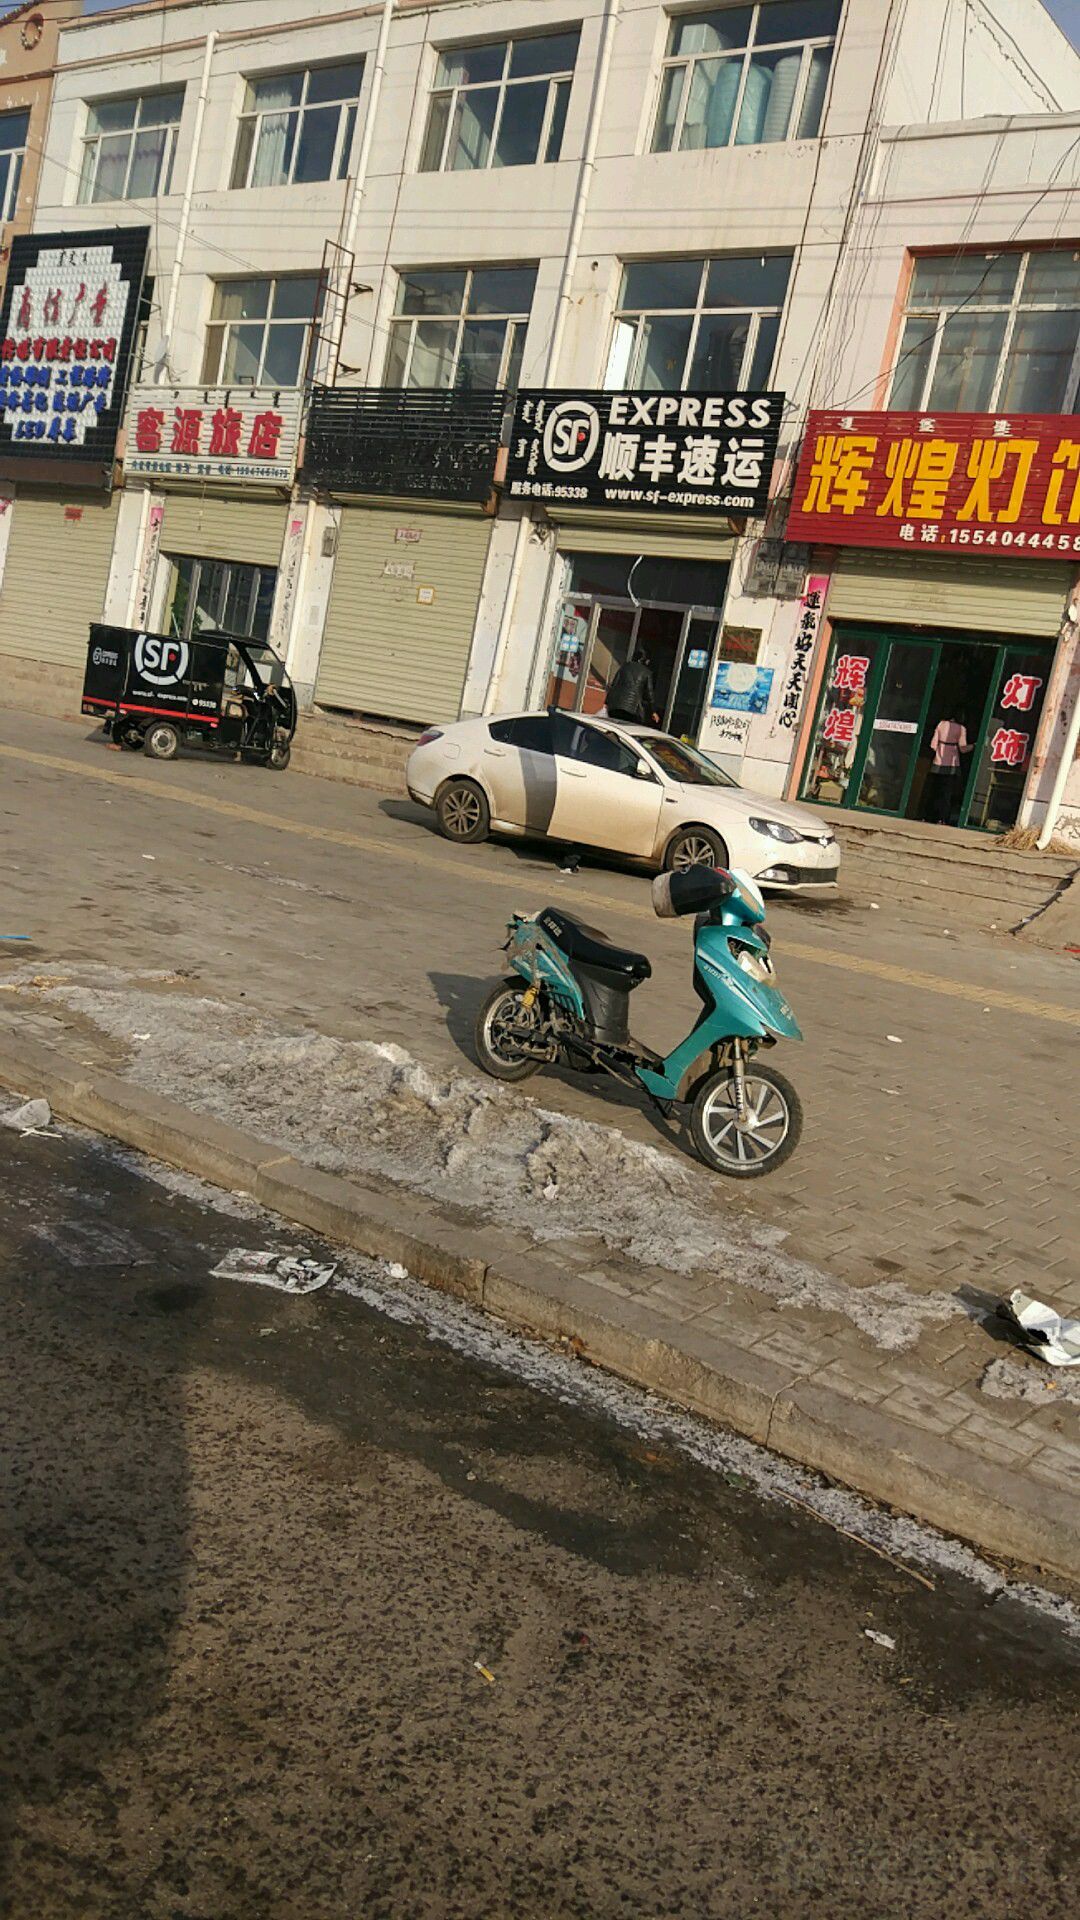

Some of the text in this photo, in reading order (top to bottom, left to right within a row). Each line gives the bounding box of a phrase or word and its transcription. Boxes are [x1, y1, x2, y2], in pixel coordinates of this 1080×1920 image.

[135, 406, 283, 458] 客源旅店
[608, 397, 772, 429] EXPRESS
[553, 418, 590, 456] SF
[598, 432, 766, 488] 顺丰速运
[604, 487, 755, 508] www.sf-express.com
[143, 638, 180, 671] SF
[823, 654, 870, 743] 辉煌
[990, 673, 1043, 766] 灯饰
